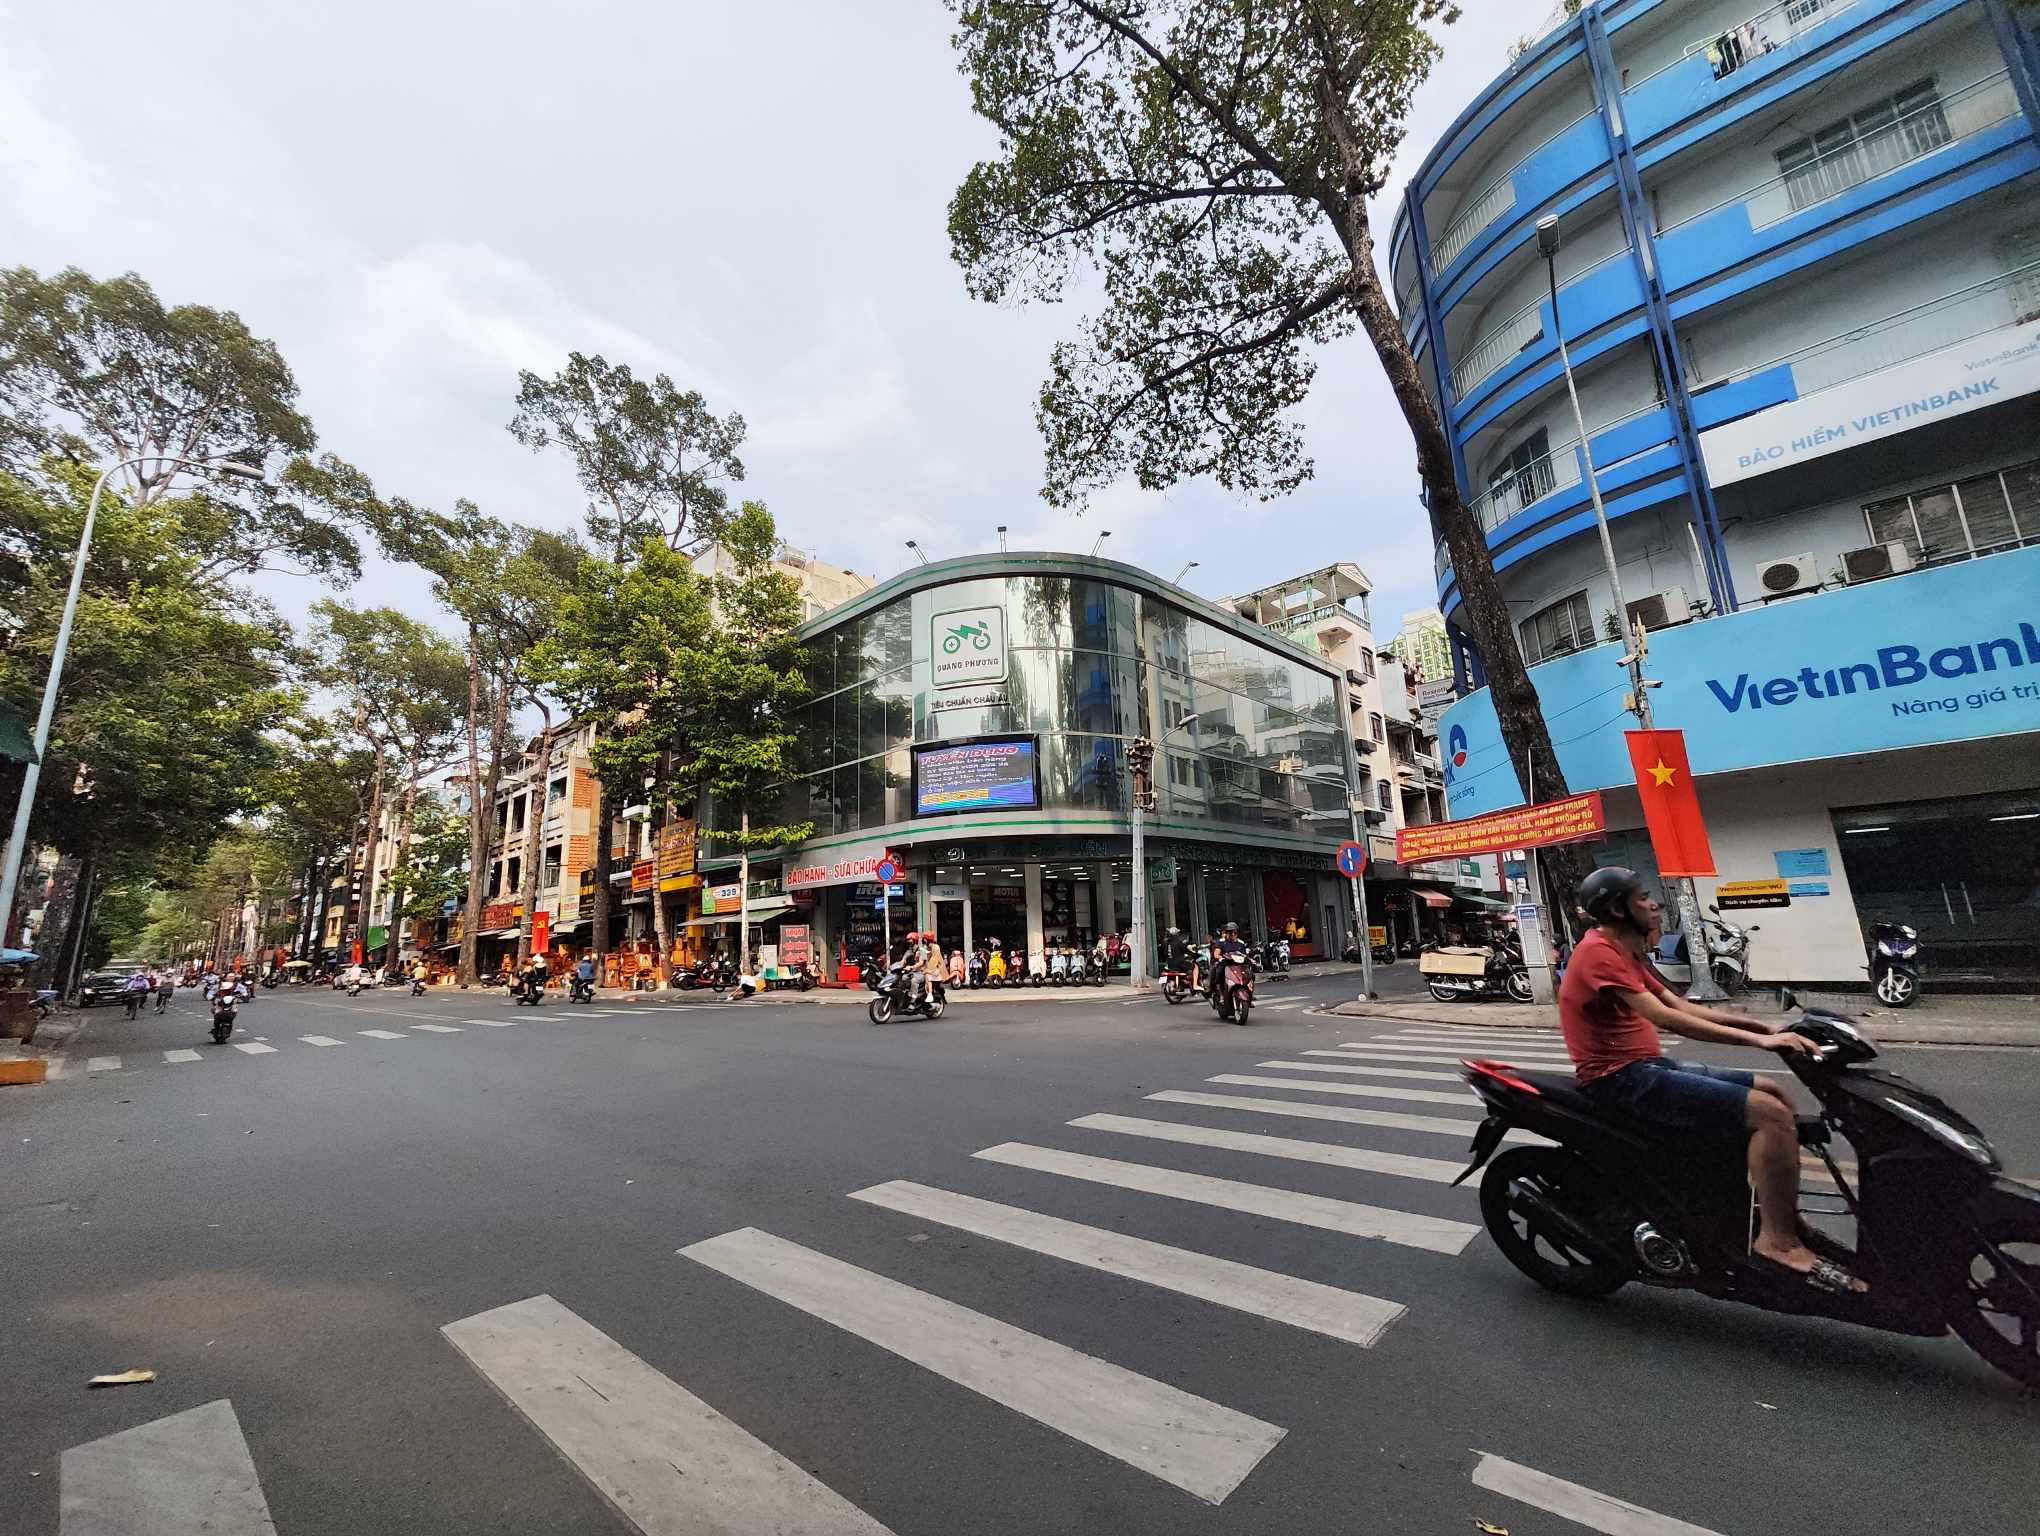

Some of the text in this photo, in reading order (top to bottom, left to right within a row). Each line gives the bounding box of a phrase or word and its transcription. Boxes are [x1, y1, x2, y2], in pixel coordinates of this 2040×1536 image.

[1738, 376, 2000, 469] BẢO HIỂM VIETINBANK
[937, 657, 999, 673] QUANG PHƯƠNG
[945, 695, 972, 708] CHUẨN
[973, 692, 996, 704] CHÂU
[1892, 681, 2040, 717] Nâng giá trị
[787, 856, 878, 885] BẢO HÀNH SỬA CHỮA
[994, 887, 1020, 897] MOTUL
